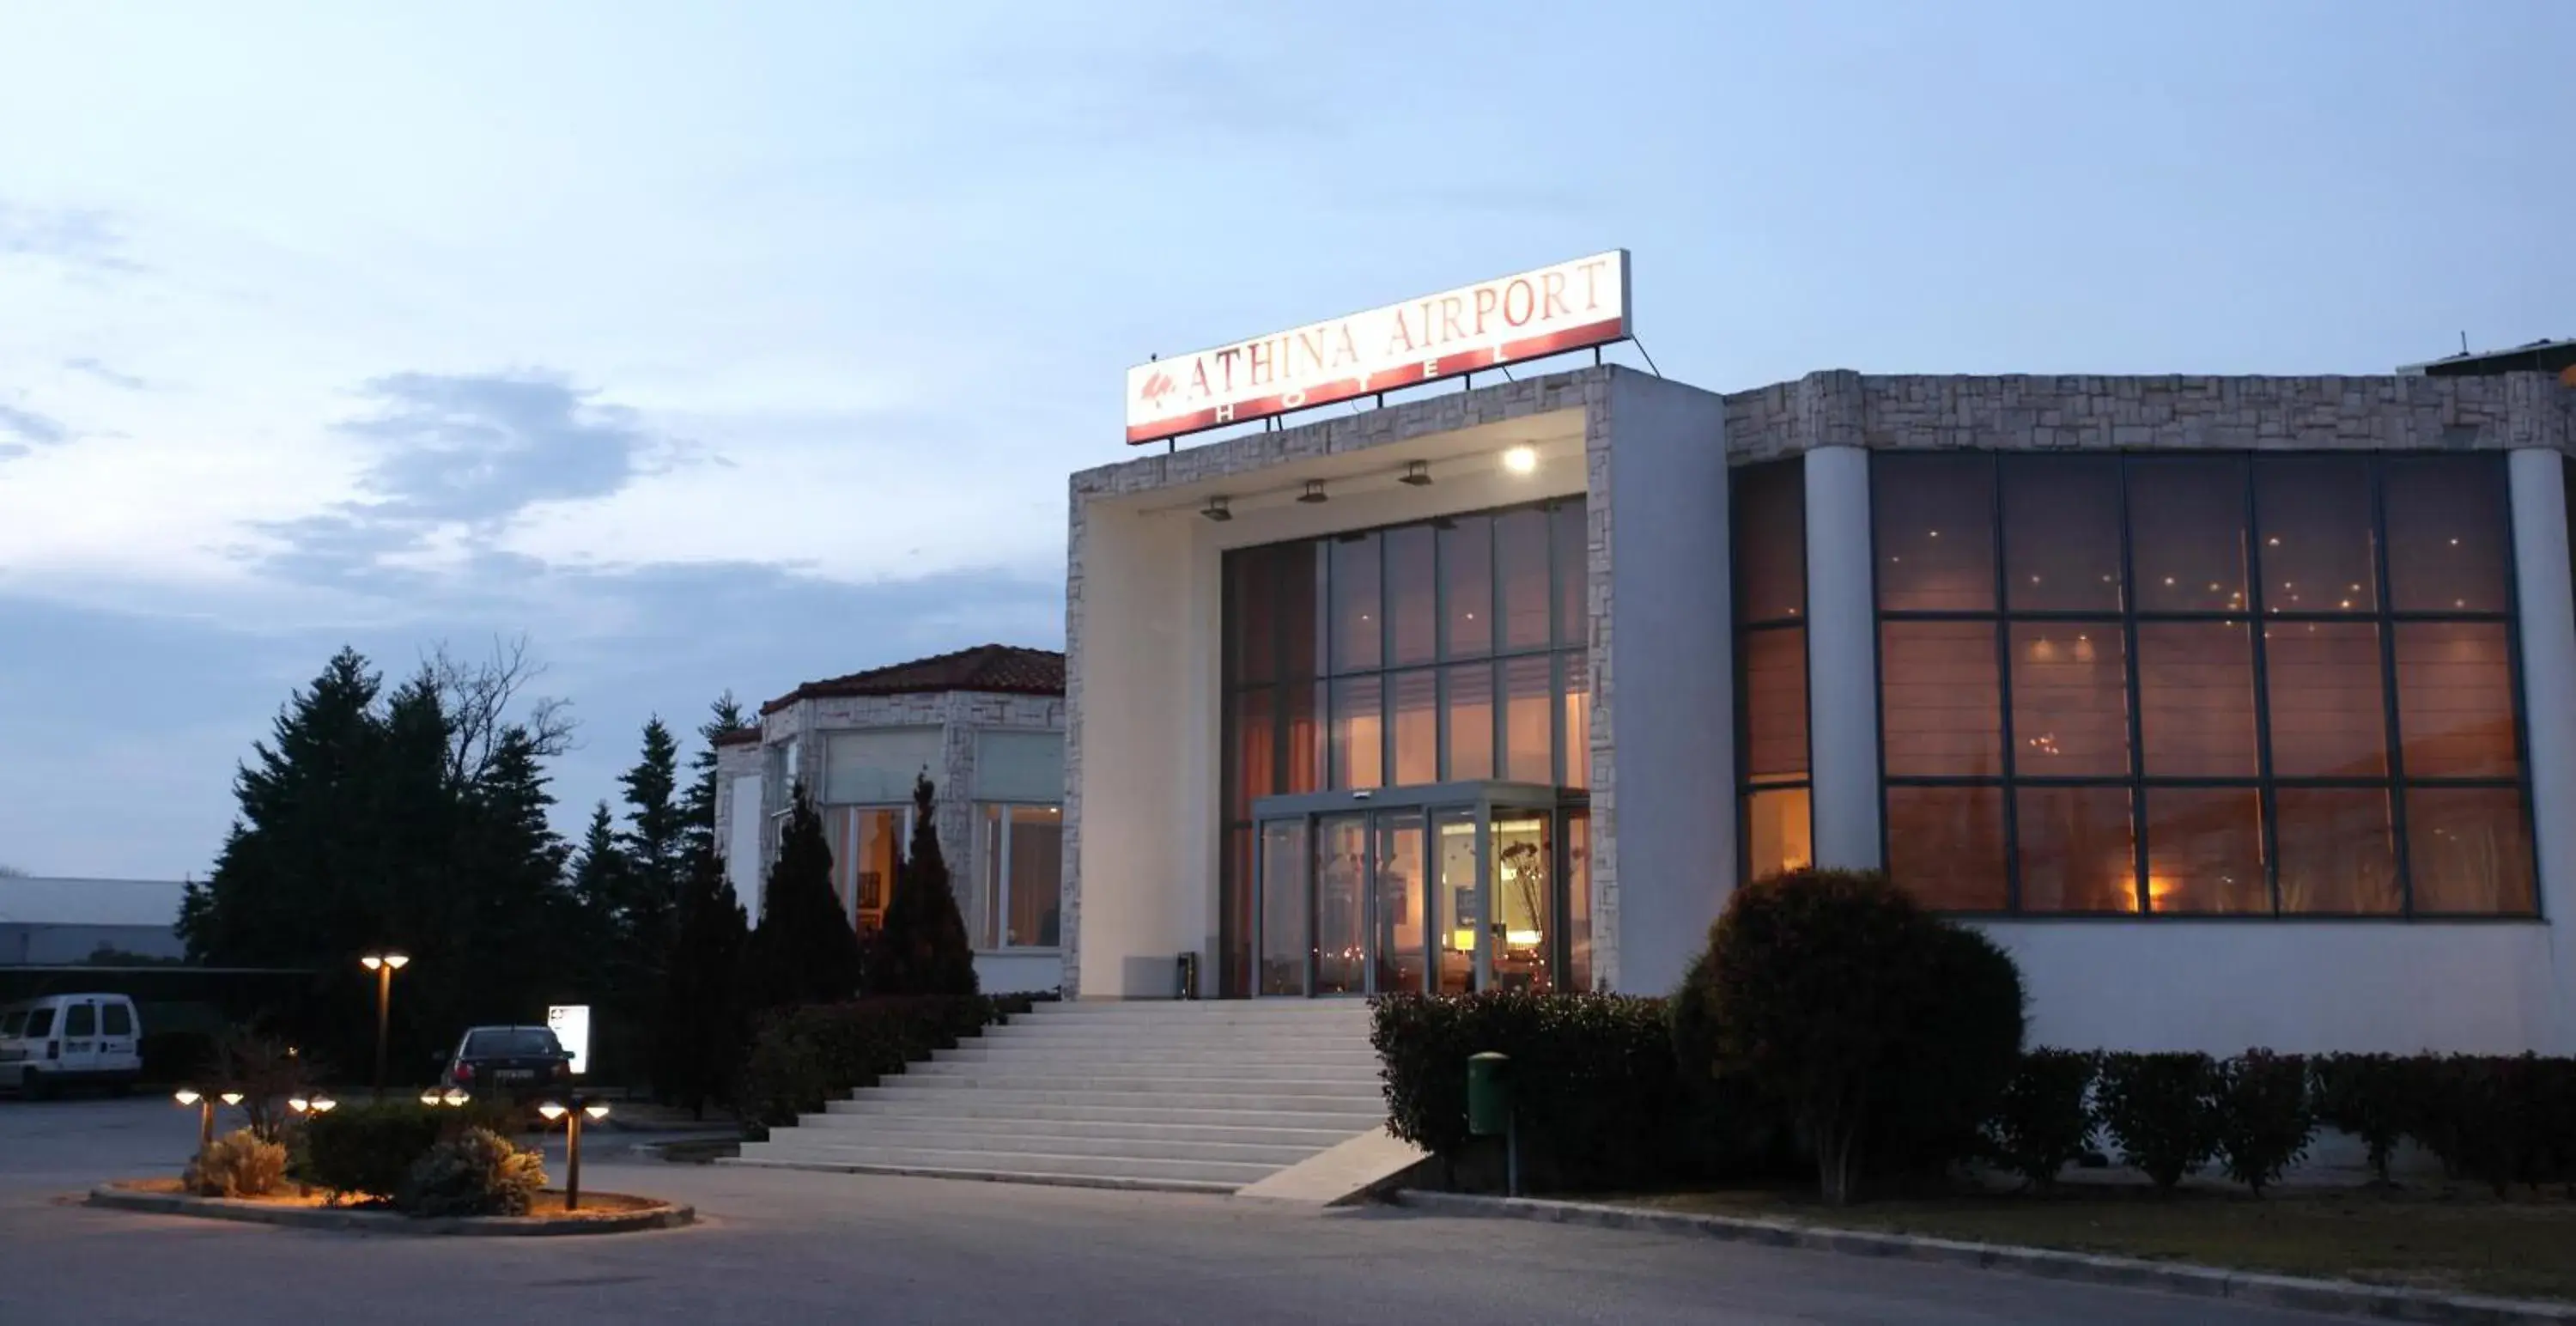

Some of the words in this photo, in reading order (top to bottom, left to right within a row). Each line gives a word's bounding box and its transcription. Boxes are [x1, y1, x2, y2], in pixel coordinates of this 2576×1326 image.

[1187, 323, 1360, 402] ATHINA
[1386, 260, 1607, 355] AIRPORT
[1216, 344, 1510, 423] HOTEL
